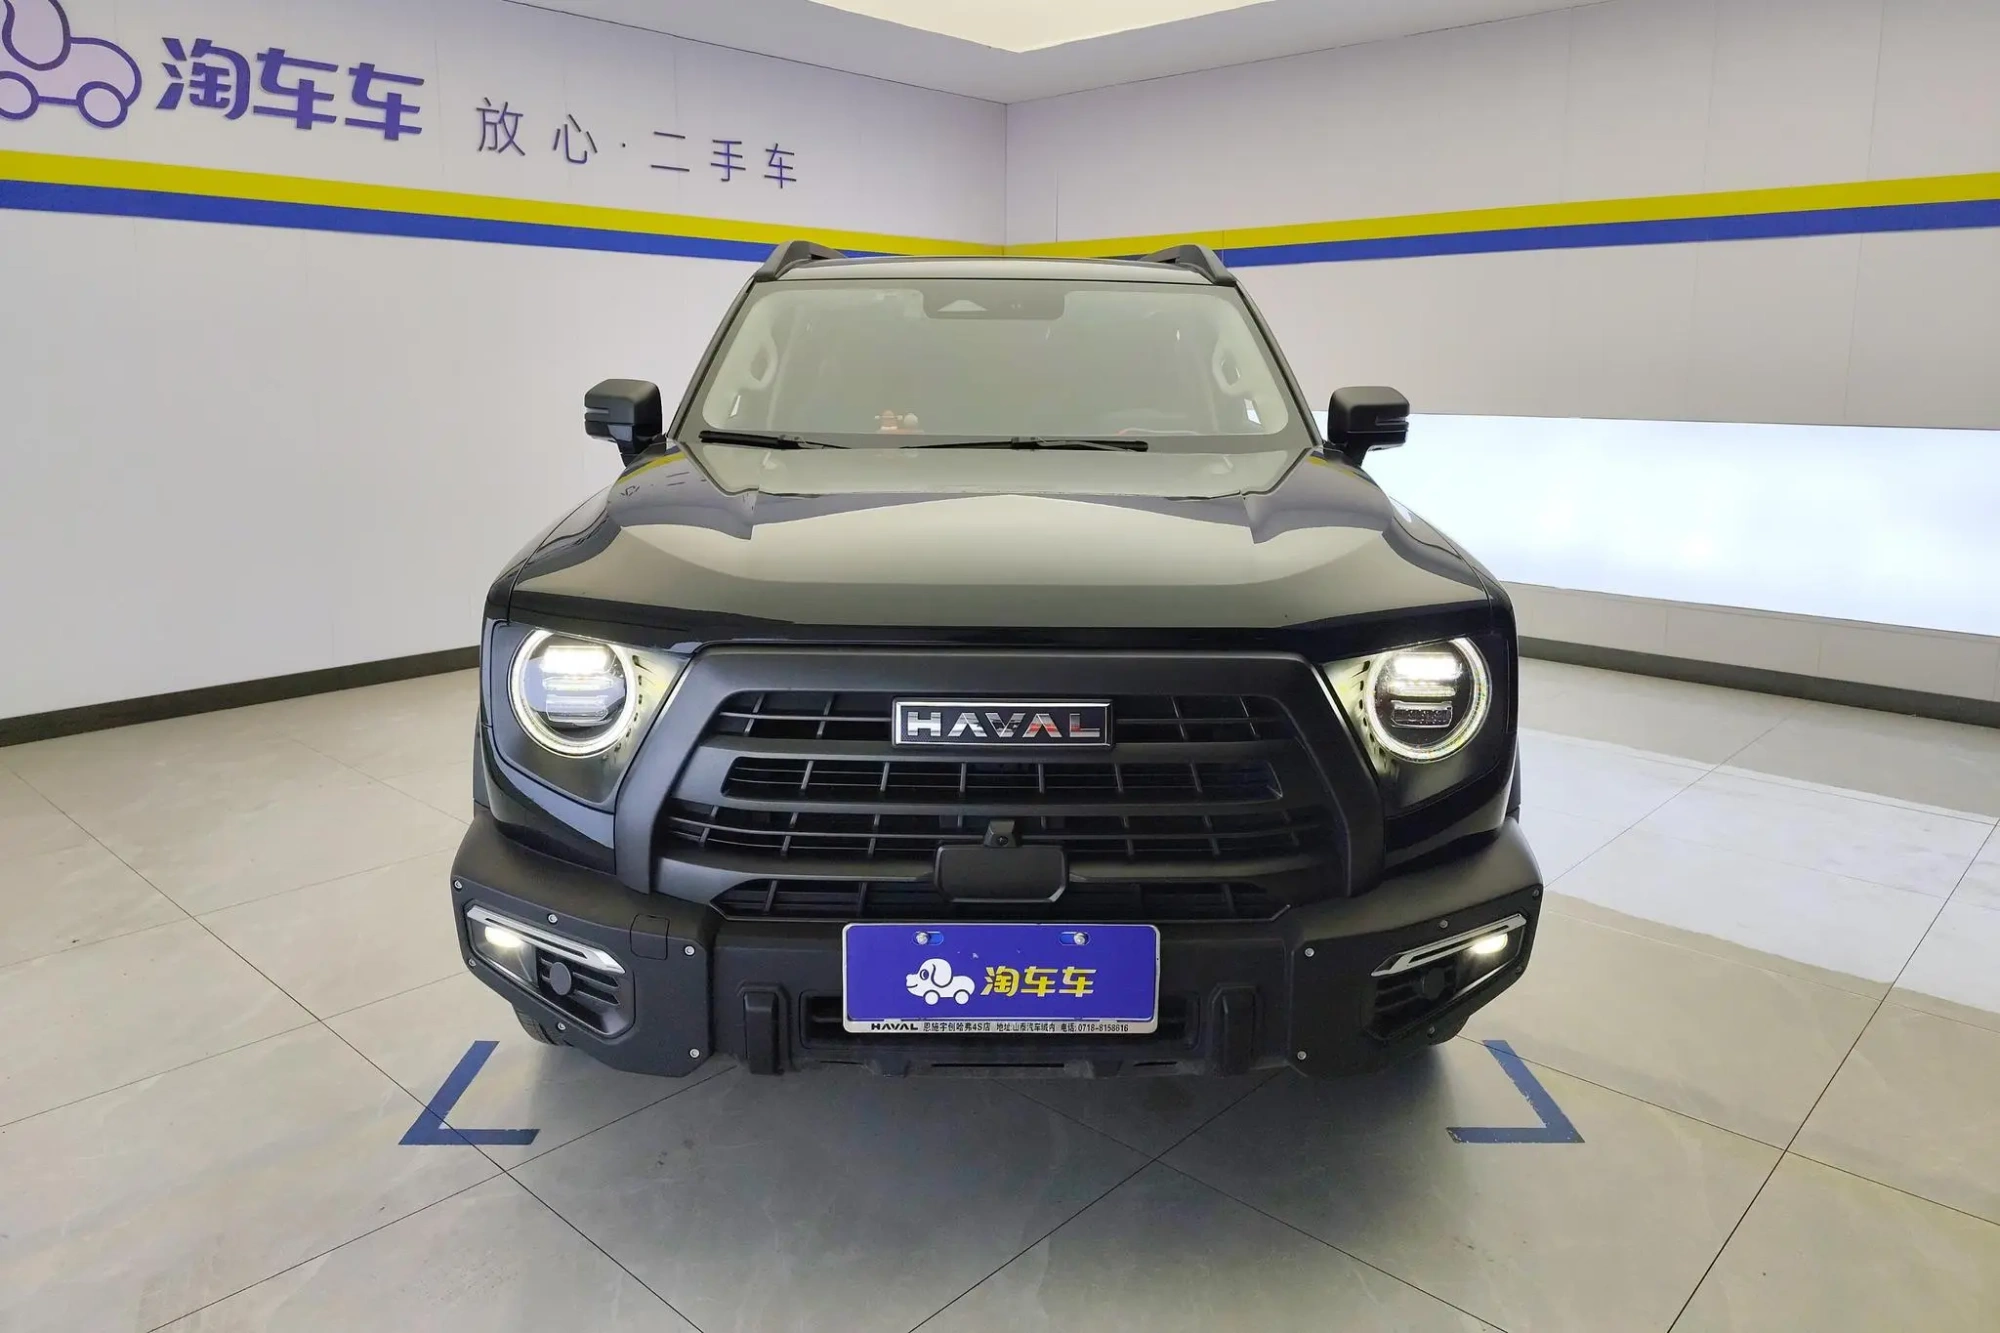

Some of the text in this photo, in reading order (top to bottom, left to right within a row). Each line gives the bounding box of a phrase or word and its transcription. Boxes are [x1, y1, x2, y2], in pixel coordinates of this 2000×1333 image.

[155, 37, 425, 141] 淘车车
[907, 711, 1100, 738] HAVAL
[980, 965, 1097, 998] 淘车车
[871, 1022, 919, 1031] HAVAL
